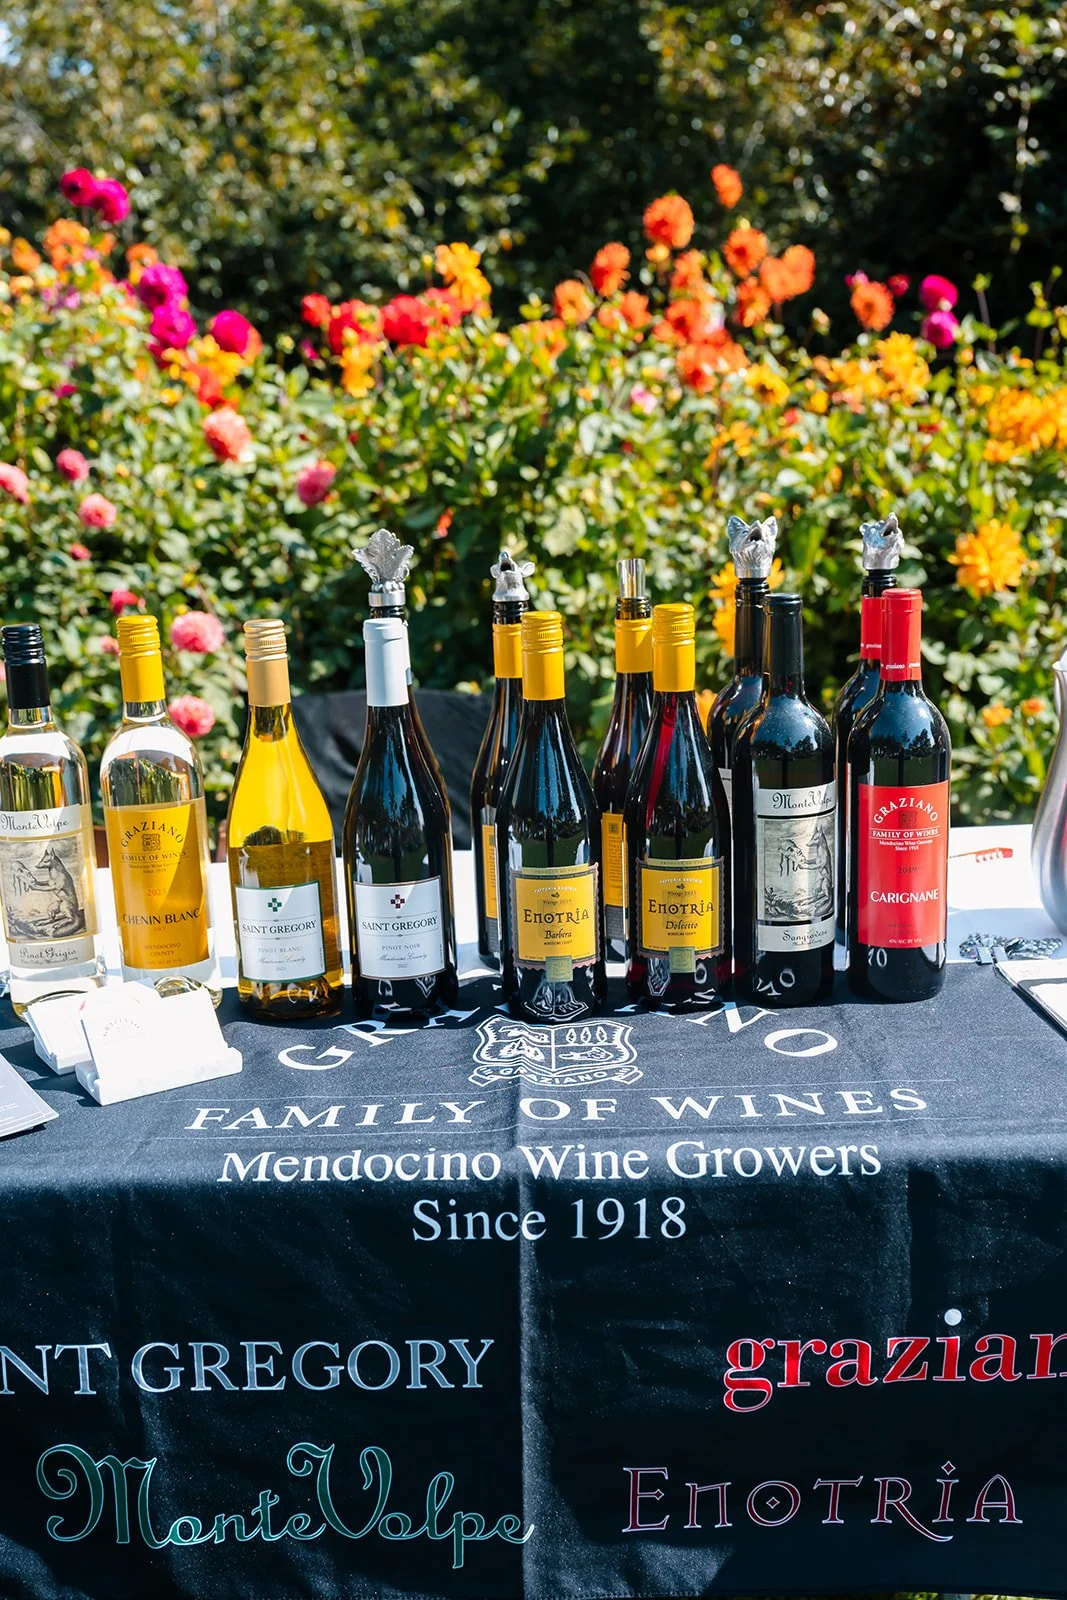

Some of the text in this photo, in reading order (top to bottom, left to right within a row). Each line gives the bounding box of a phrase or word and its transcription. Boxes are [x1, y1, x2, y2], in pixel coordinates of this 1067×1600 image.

[873, 798, 938, 824] GRAZIANO
[121, 821, 184, 847] GRAZIANO
[872, 830, 900, 838] FAMILY
[916, 828, 938, 837] WINES
[870, 888, 939, 904] CARIGNANE
[122, 907, 200, 925] CHENIN BLANC
[362, 916, 437, 931] SAINT GREGORY
[665, 920, 699, 929] Dolcetto
[242, 920, 317, 934] SAINT GREGORY
[544, 928, 572, 939] Barbera
[45, 946, 76, 958] Grigio
[500, 1066, 607, 1084] GRAZIANO
[184, 1088, 927, 1130] FAMILY OF WINES
[216, 1140, 881, 1182] Mendocino Wine Growers
[412, 1196, 687, 1241] Since 1918
[131, 1339, 494, 1393] GREGORY
[36, 1442, 535, 1569] MonteVolpe
